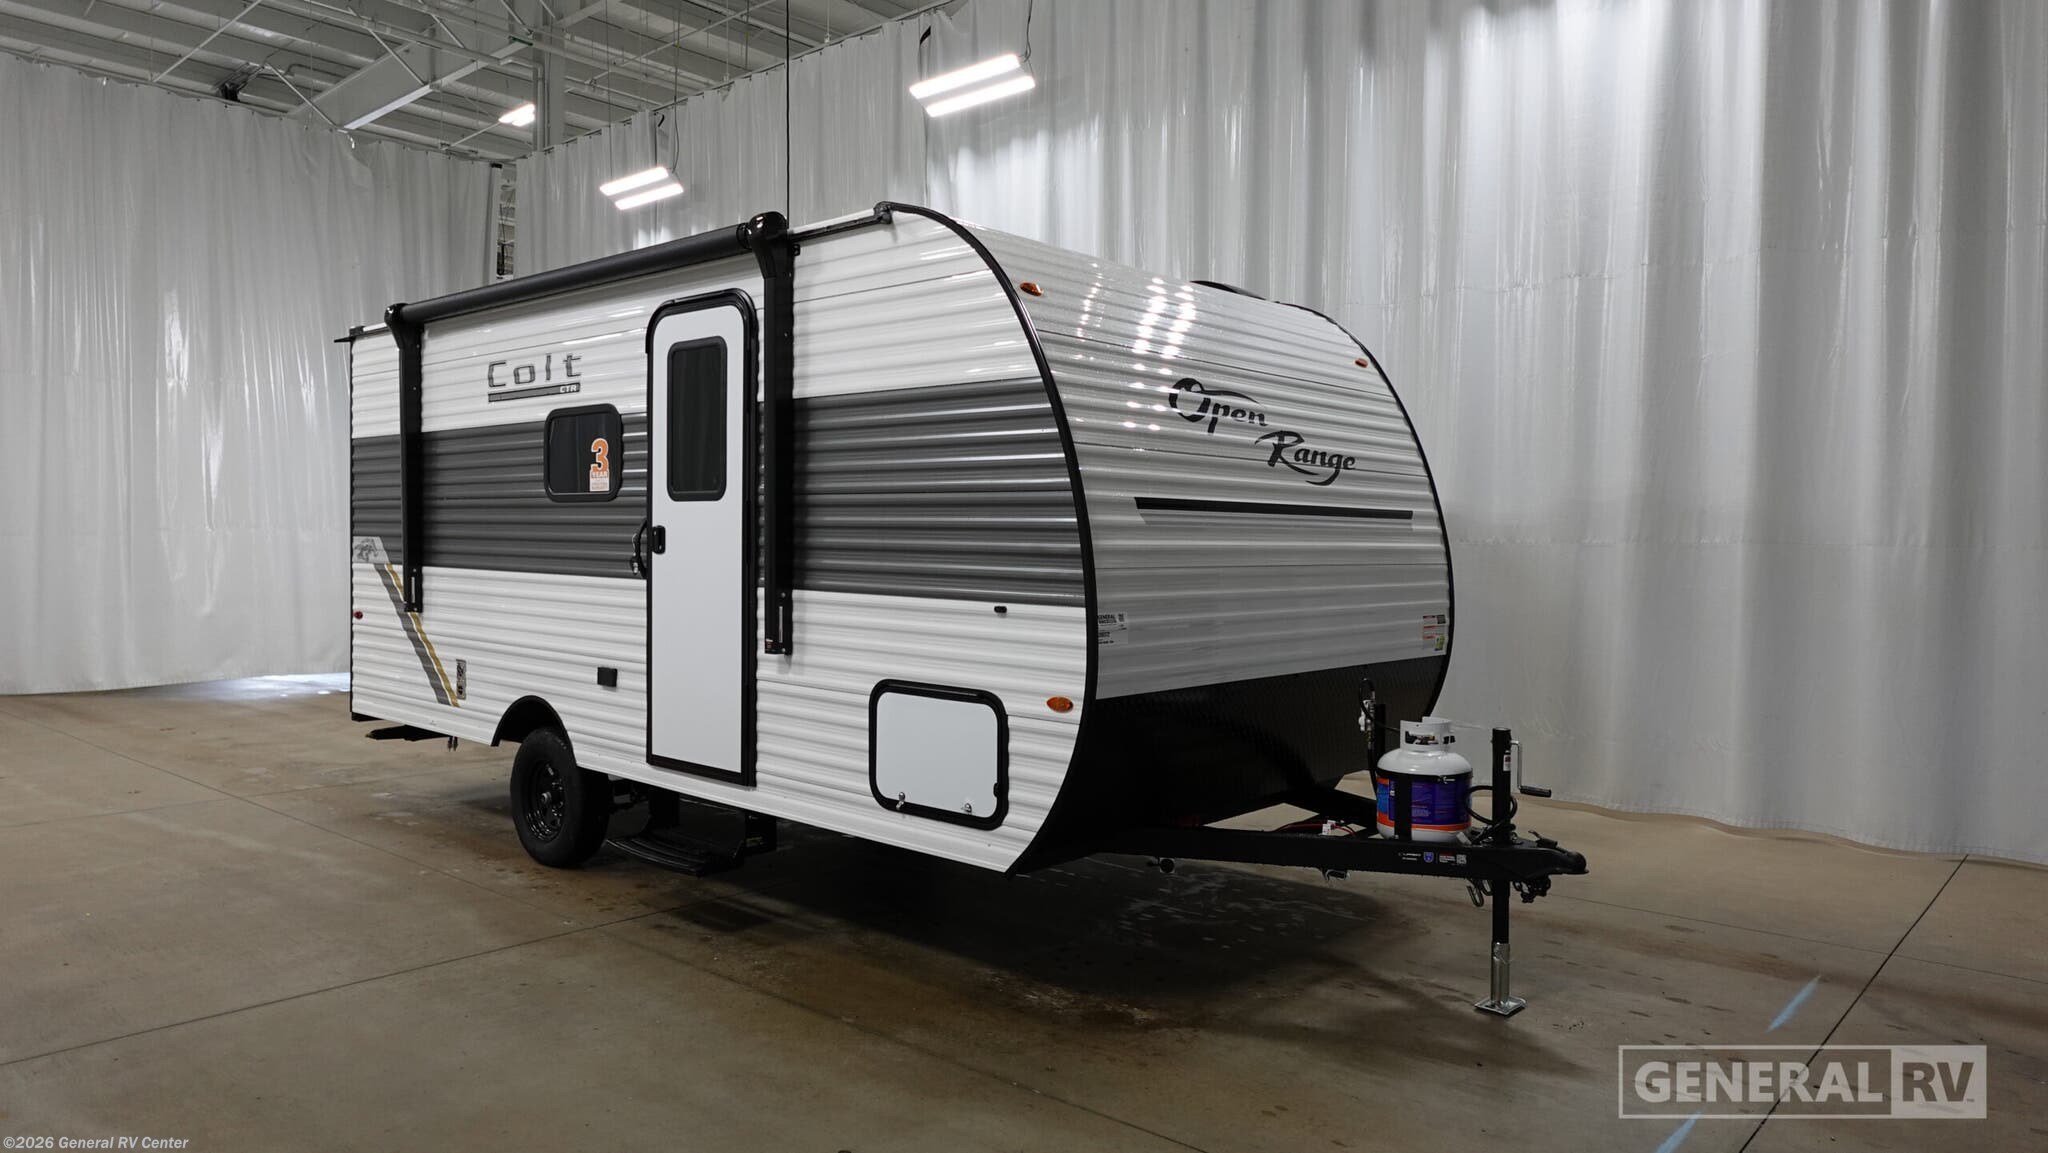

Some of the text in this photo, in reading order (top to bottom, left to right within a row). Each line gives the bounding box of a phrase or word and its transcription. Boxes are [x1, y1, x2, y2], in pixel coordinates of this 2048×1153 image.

[488, 354, 582, 388] Colt
[559, 384, 578, 393] CTR
[1168, 377, 1269, 434] Open
[591, 438, 609, 472] 3
[1254, 430, 1356, 486] Range
